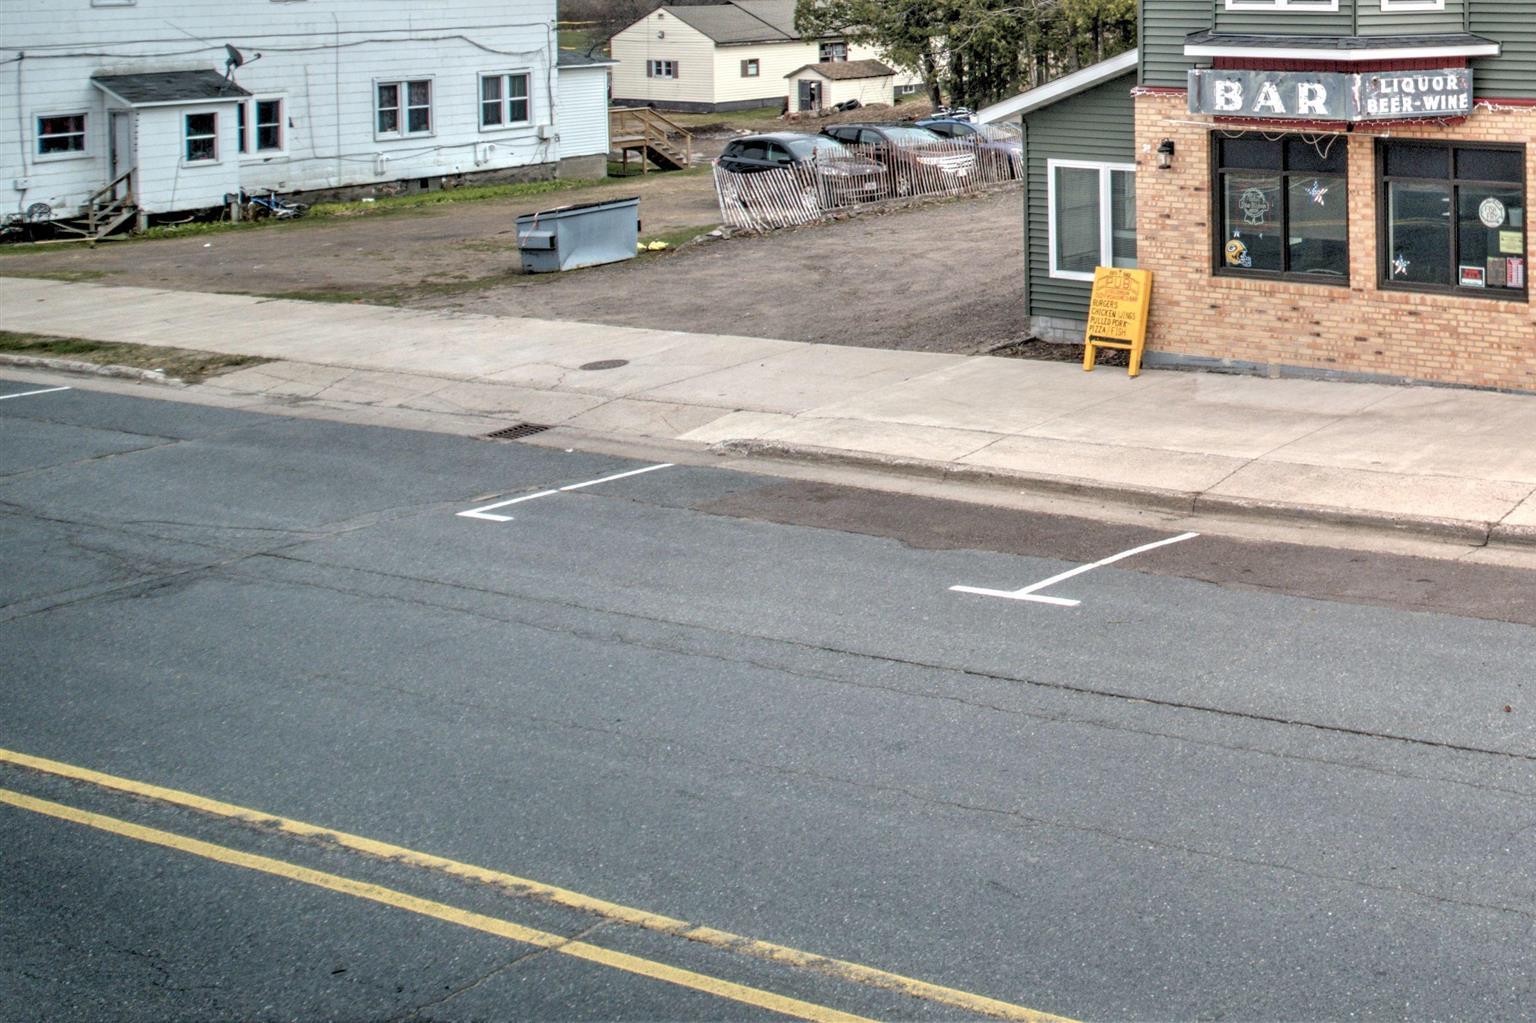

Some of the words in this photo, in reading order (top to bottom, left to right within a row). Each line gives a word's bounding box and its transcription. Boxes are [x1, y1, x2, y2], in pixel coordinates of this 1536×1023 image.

[1380, 74, 1459, 94] LIQUOR
[1213, 80, 1329, 114] BAR
[1367, 93, 1469, 113] BEER-WINE
[1092, 298, 1118, 309] BURGERS
[1091, 307, 1117, 318] CHICKEN
[1118, 311, 1136, 321] WINGS
[1090, 316, 1112, 326] PULLED
[1112, 318, 1128, 328] PORK
[1089, 324, 1106, 334] PIZZA
[1110, 326, 1127, 337] FISH
